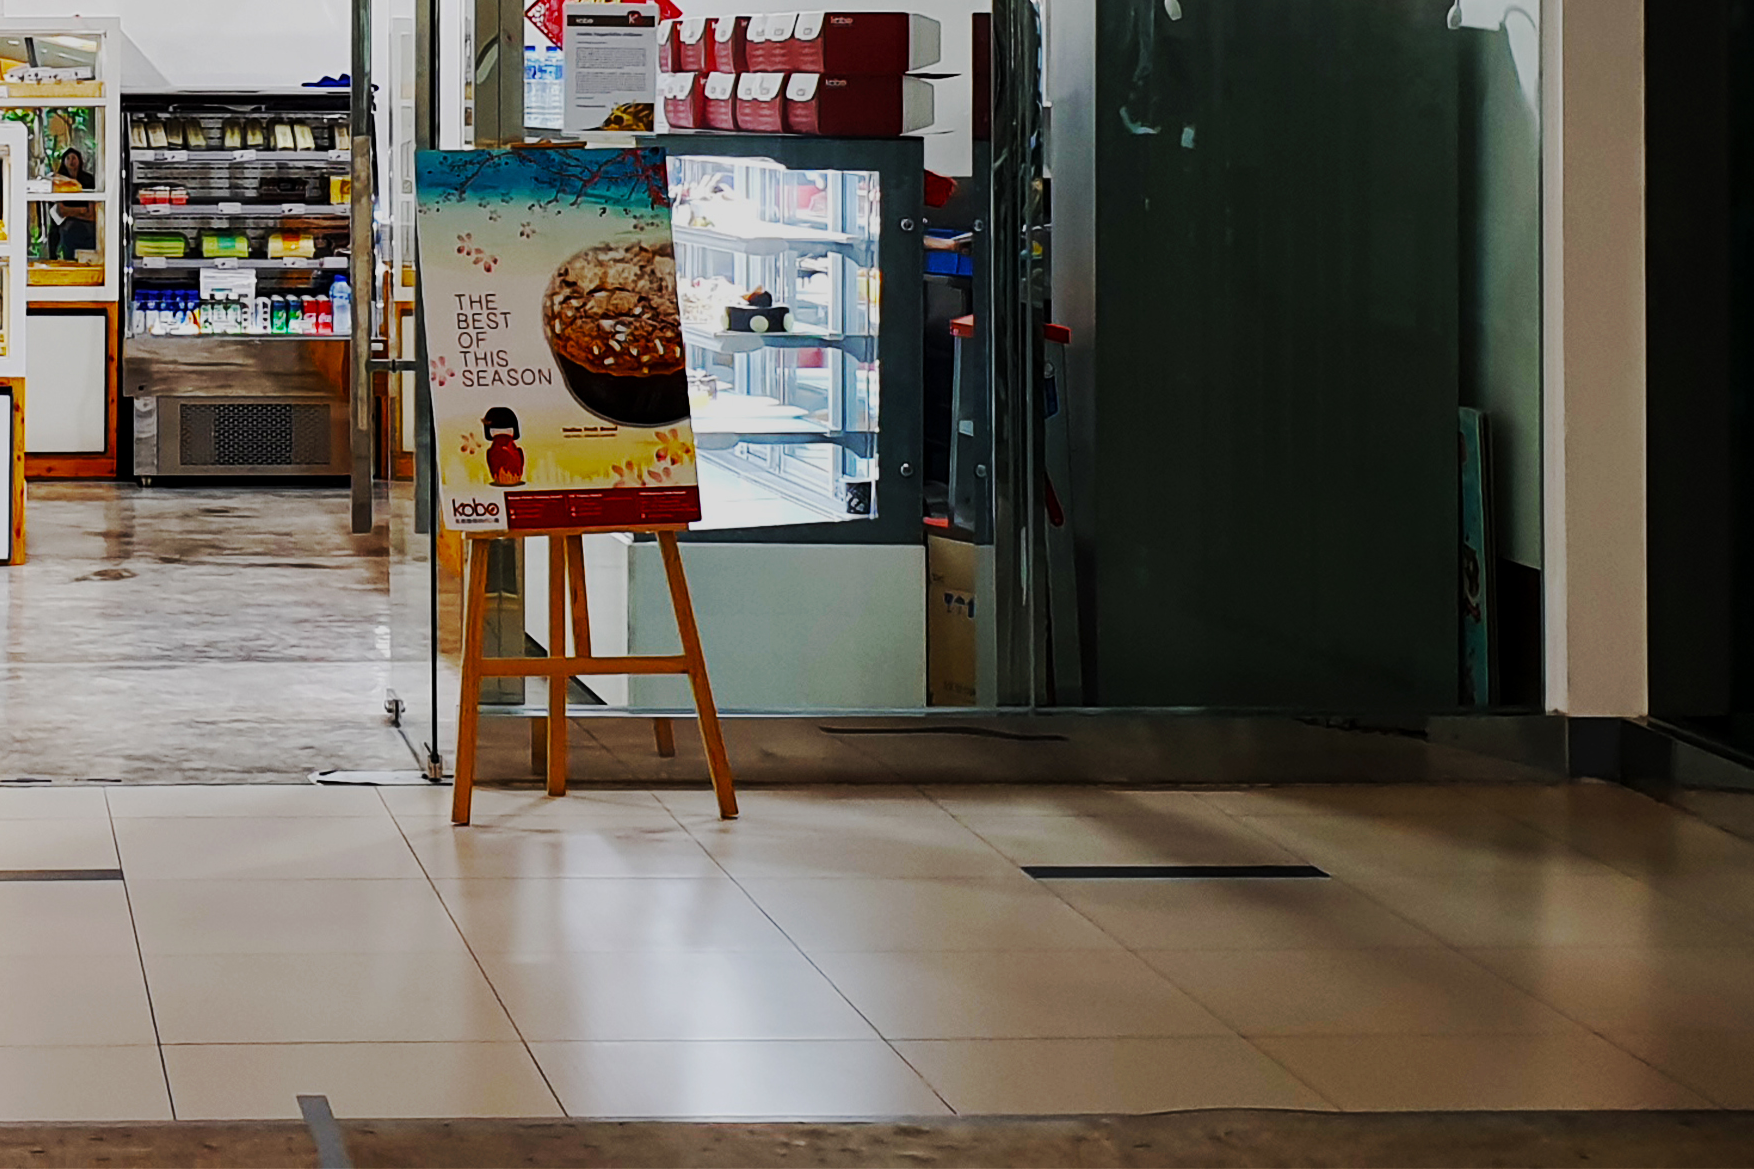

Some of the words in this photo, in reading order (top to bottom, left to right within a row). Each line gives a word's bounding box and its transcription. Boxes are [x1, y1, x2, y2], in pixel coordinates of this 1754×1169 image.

[454, 293, 498, 311] THE
[457, 311, 512, 330] BEST
[458, 331, 488, 349] OF
[459, 349, 509, 368] THIS
[462, 368, 552, 388] SEASON
